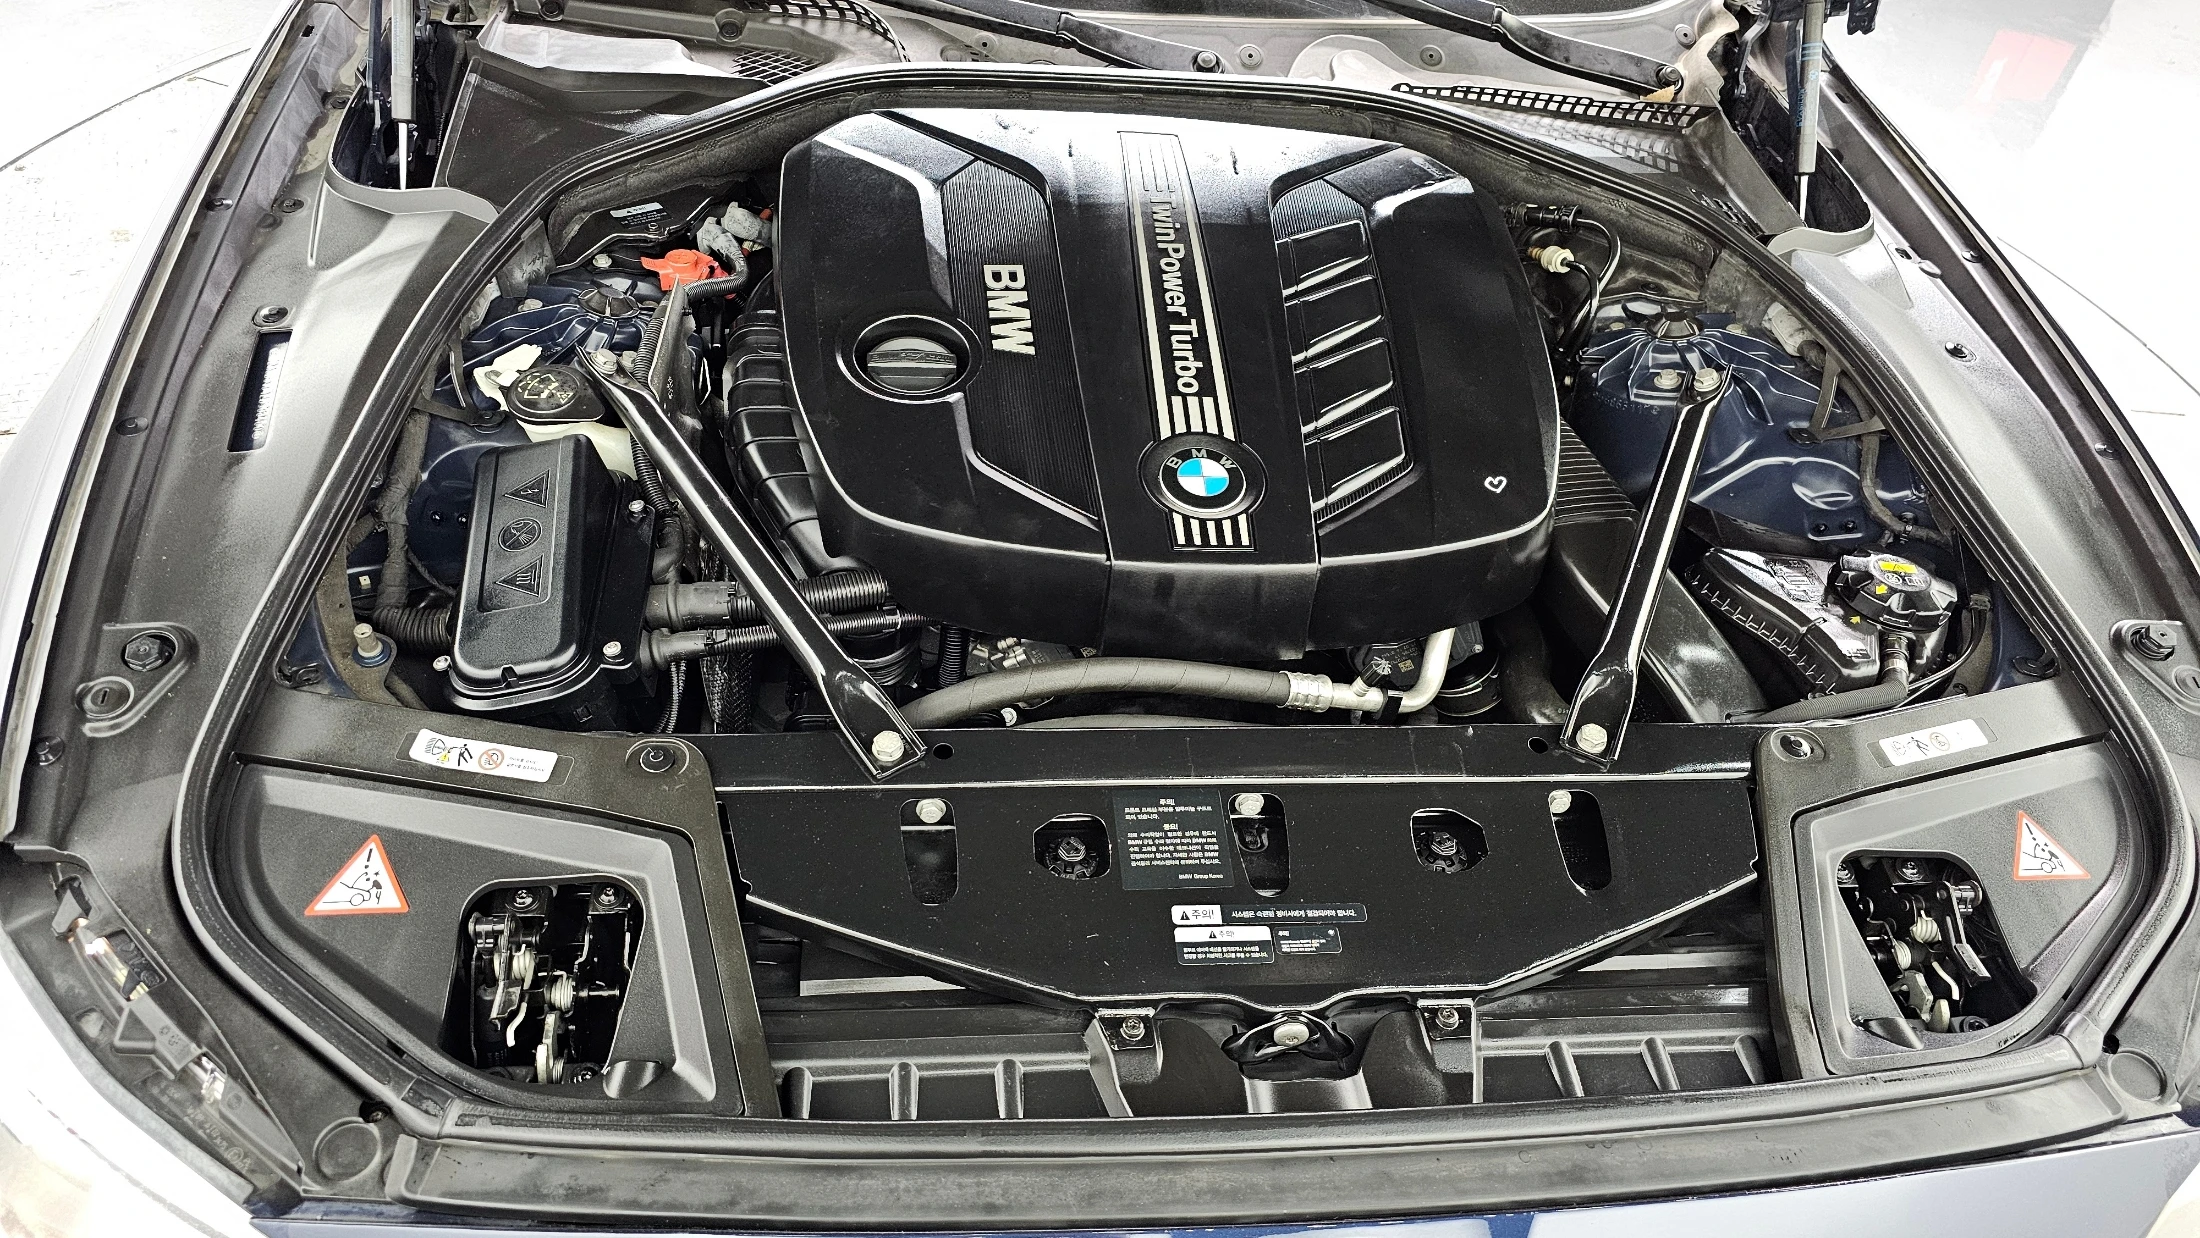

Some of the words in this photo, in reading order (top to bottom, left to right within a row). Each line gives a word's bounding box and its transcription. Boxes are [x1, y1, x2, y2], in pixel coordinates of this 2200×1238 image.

[983, 263, 1037, 356] BMW
[1149, 196, 1188, 317] TwinPower
[1169, 318, 1202, 395] Turbo
[1167, 448, 1237, 470] BMW
[1191, 909, 1215, 920] 주의!
